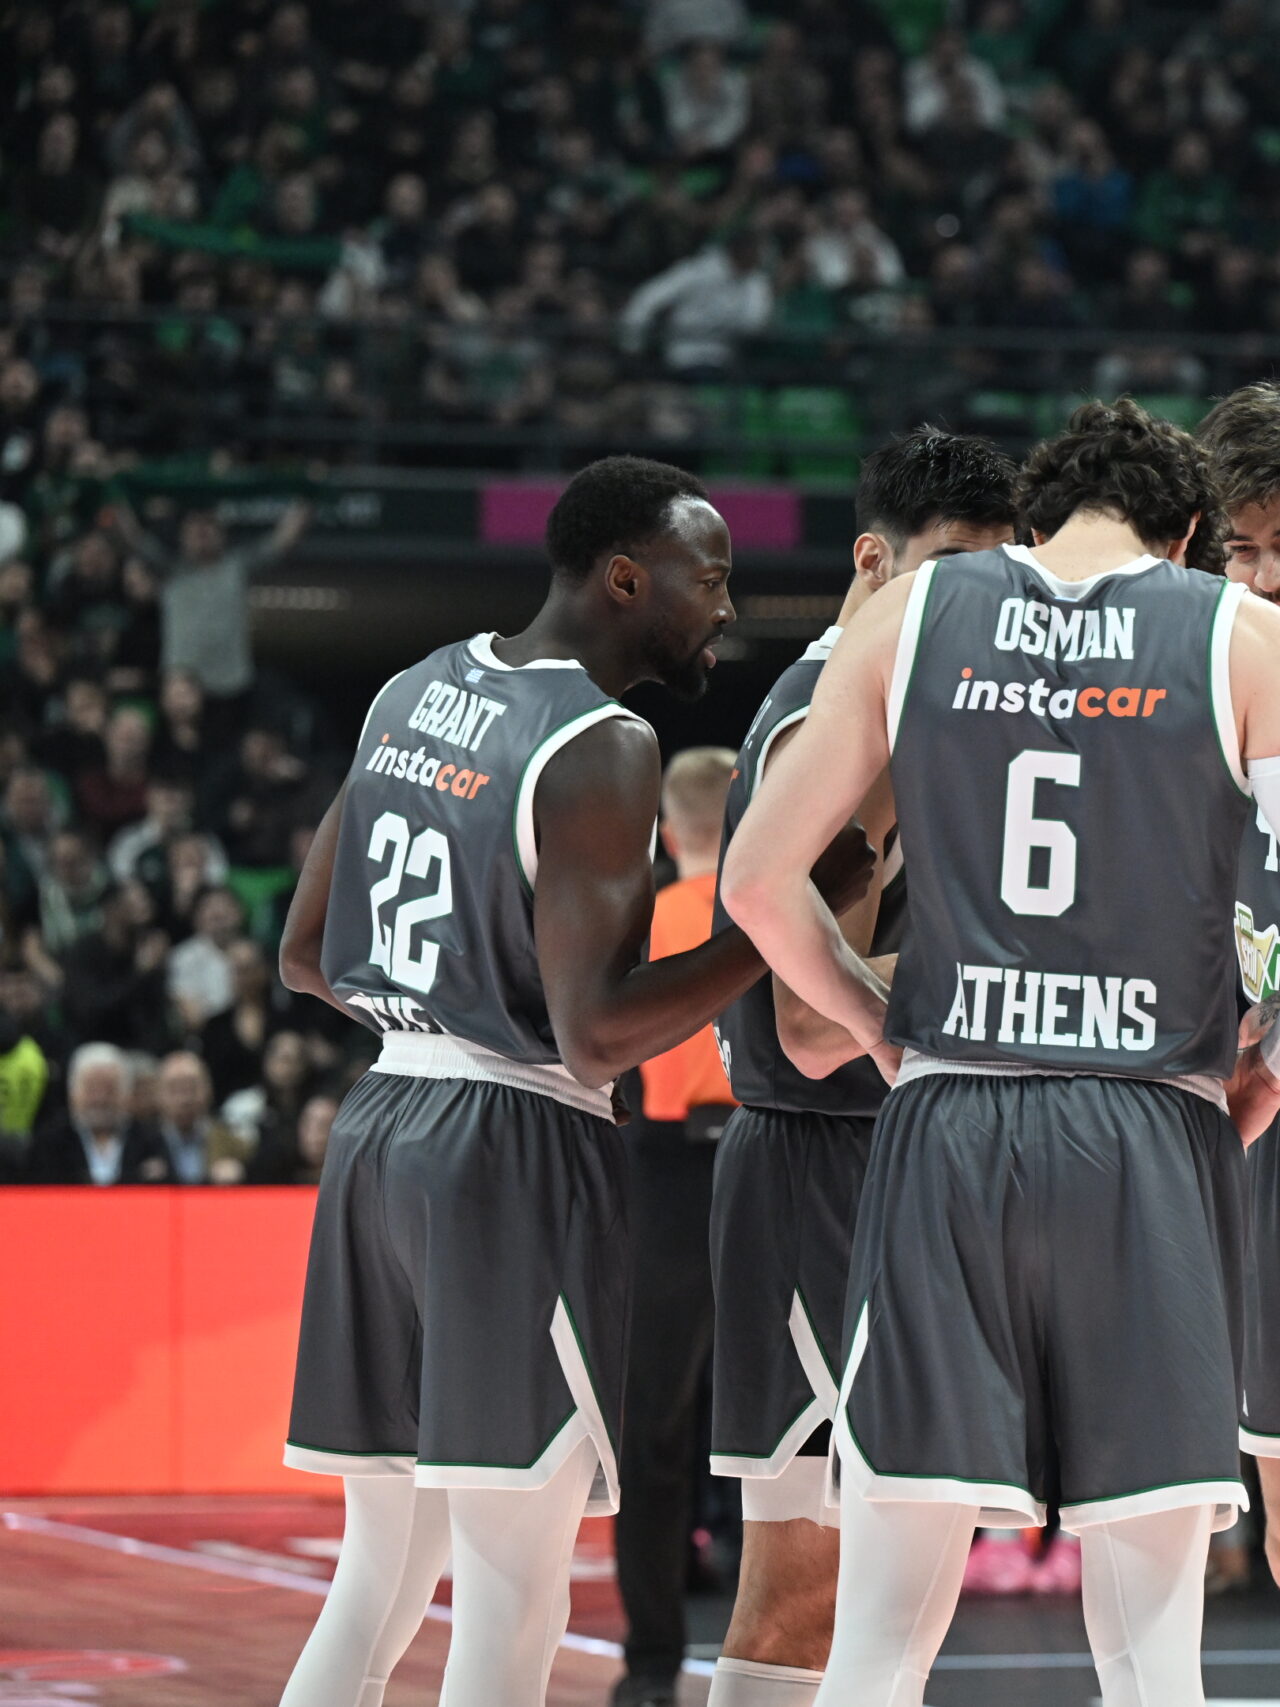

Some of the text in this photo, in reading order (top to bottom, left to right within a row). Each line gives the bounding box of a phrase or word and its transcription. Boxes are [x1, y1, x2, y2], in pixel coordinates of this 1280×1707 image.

[994, 597, 1137, 662] OSMAN
[408, 679, 507, 752] GRANT
[951, 667, 1167, 720] instacar
[365, 733, 490, 801] instacar
[1000, 749, 1082, 917] 6
[367, 811, 453, 994] 22
[941, 962, 1158, 1051] ATHENS
